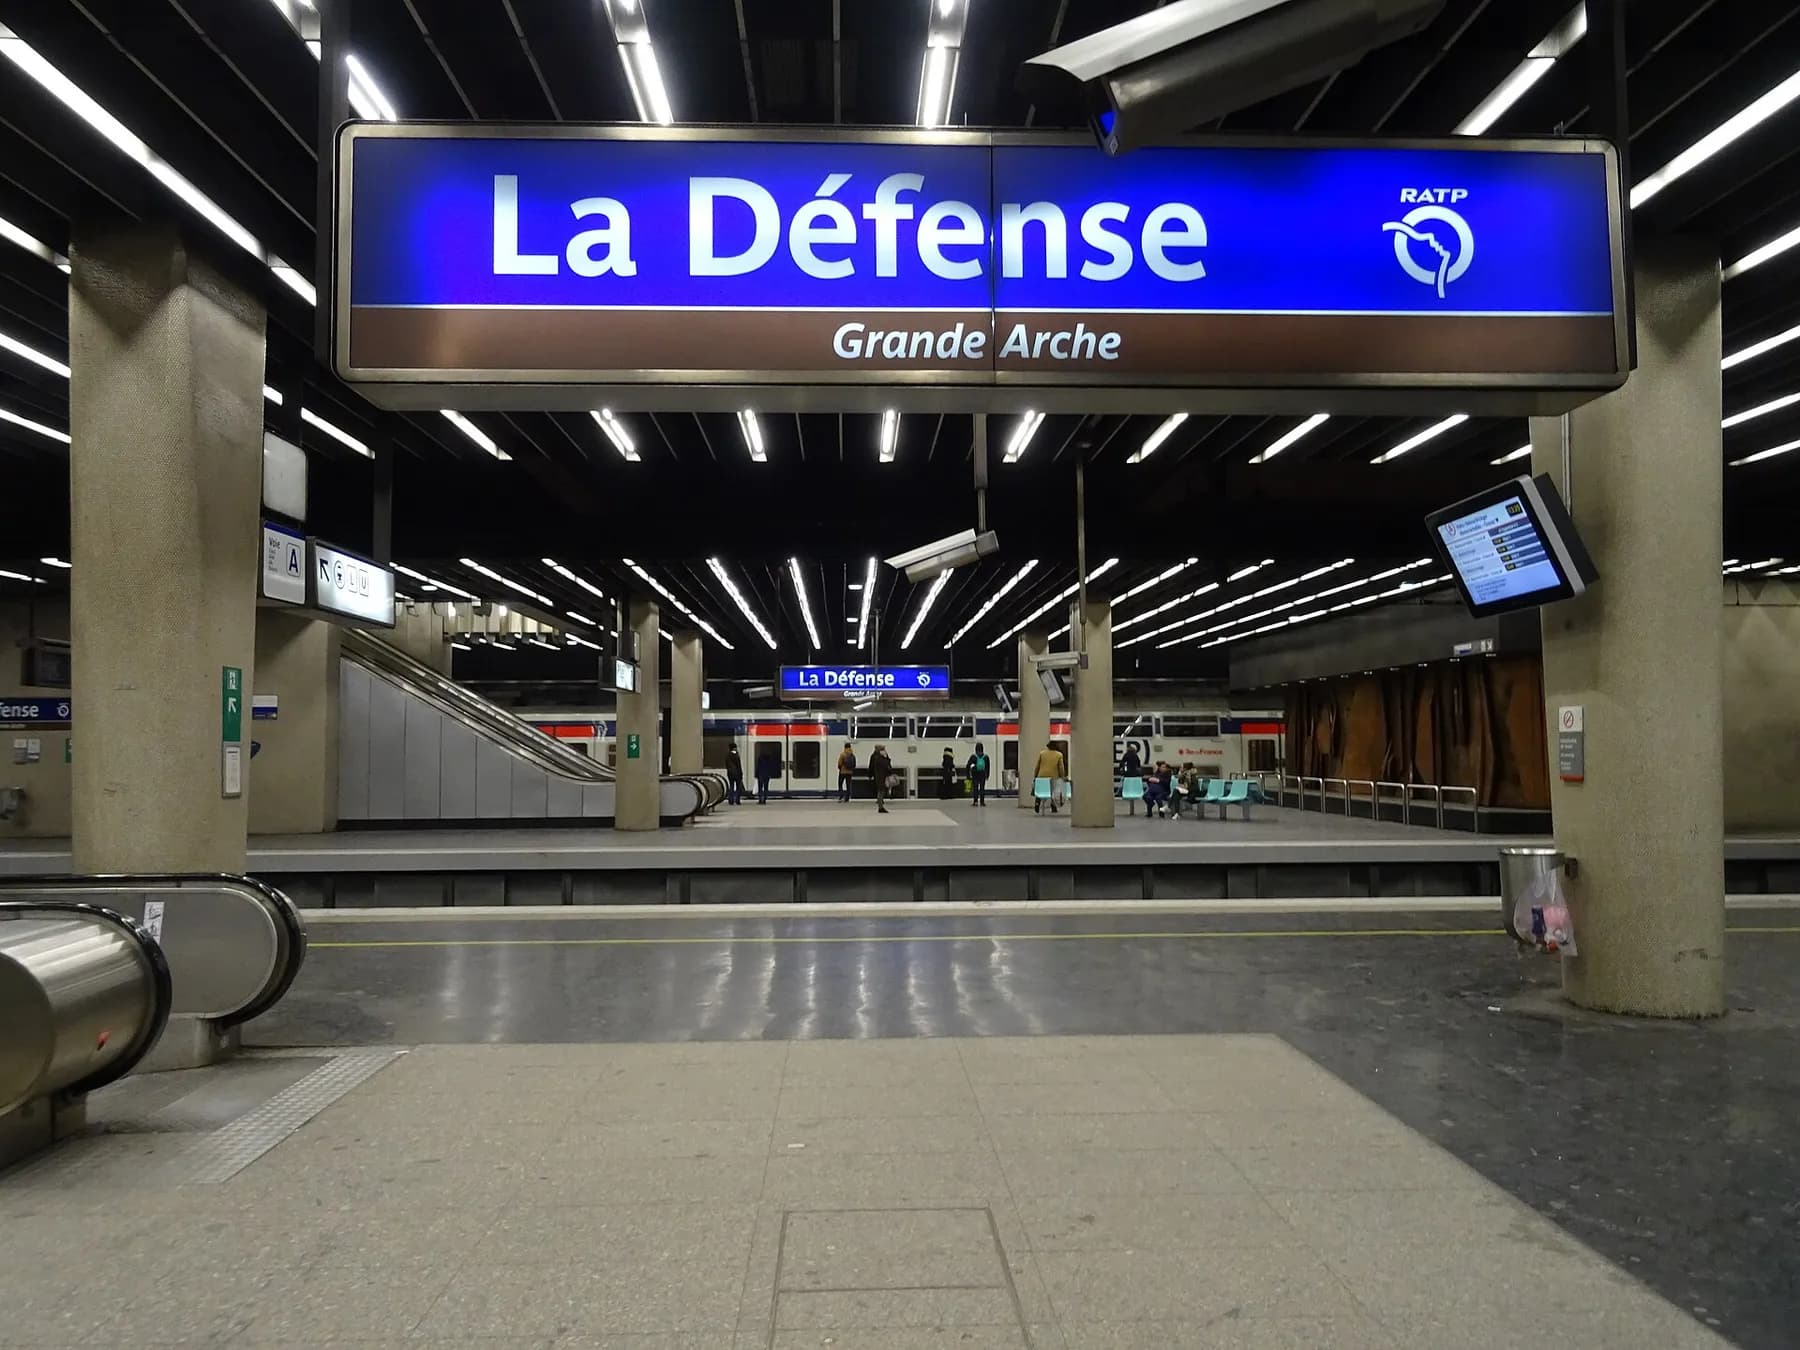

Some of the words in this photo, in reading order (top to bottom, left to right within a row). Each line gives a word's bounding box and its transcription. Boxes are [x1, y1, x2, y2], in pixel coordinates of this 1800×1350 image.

[1400, 188, 1469, 203] RATP
[493, 175, 637, 278] La
[688, 173, 1208, 282] Défense
[832, 321, 986, 360] Grande
[999, 322, 1122, 360] Arche
[288, 548, 299, 573] A
[799, 671, 819, 686] La
[824, 670, 895, 687] Défense
